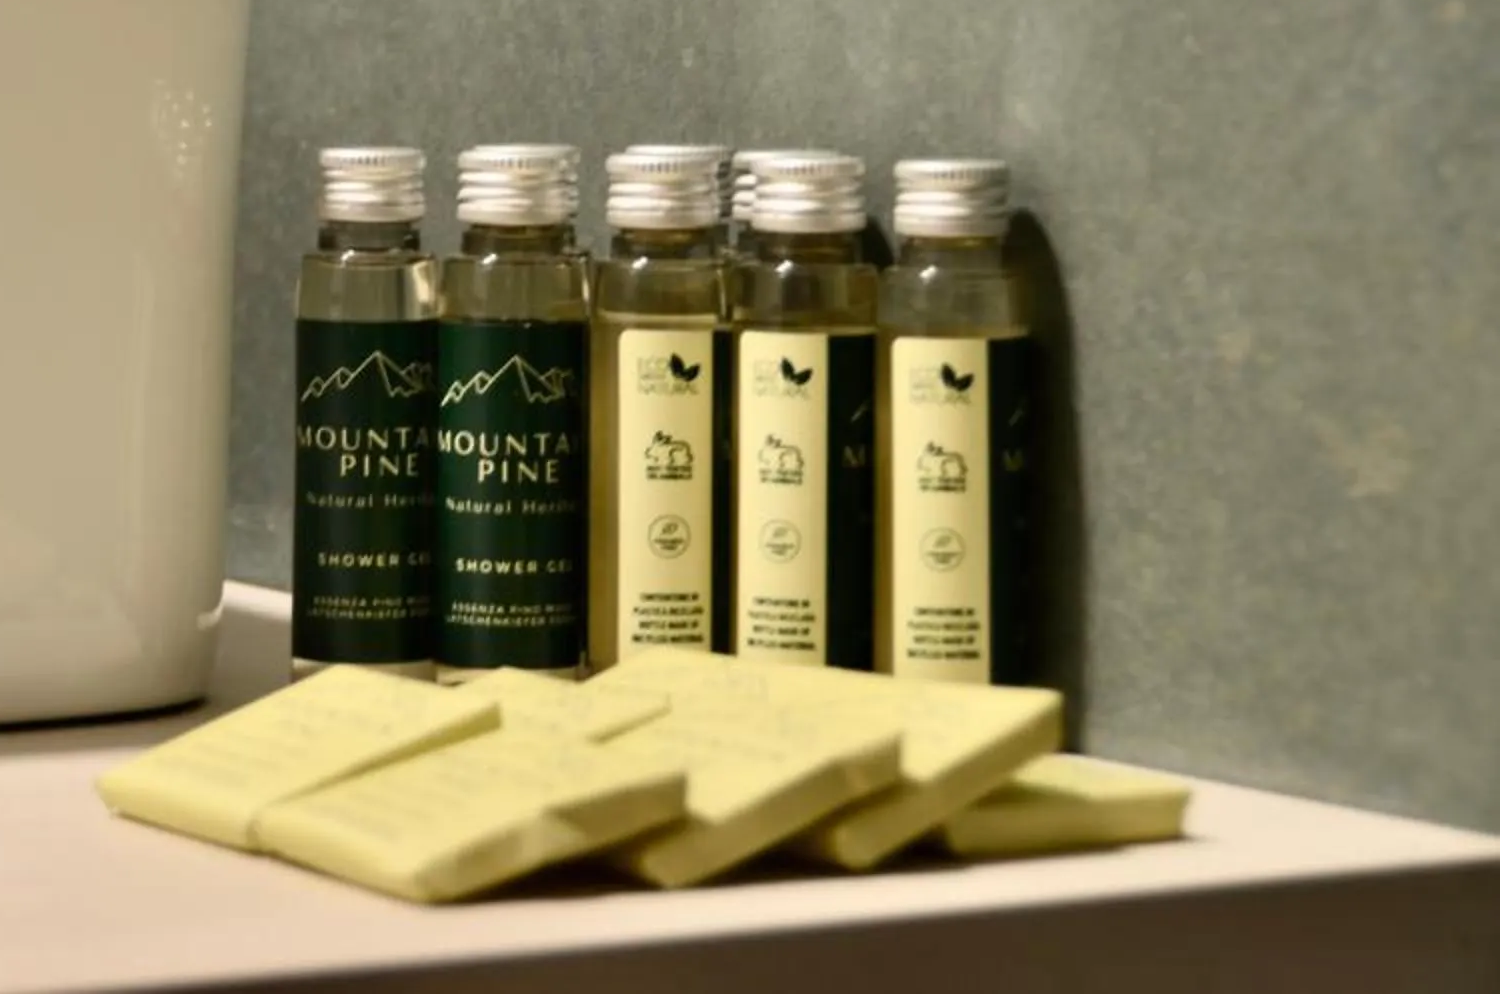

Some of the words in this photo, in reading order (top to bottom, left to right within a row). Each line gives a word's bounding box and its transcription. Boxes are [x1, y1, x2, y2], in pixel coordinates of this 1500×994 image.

[339, 452, 419, 477] PINE
[478, 459, 559, 483] PINE
[445, 496, 512, 515] Natural
[318, 552, 400, 568] SHOWER
[455, 557, 537, 574] SHOWER
